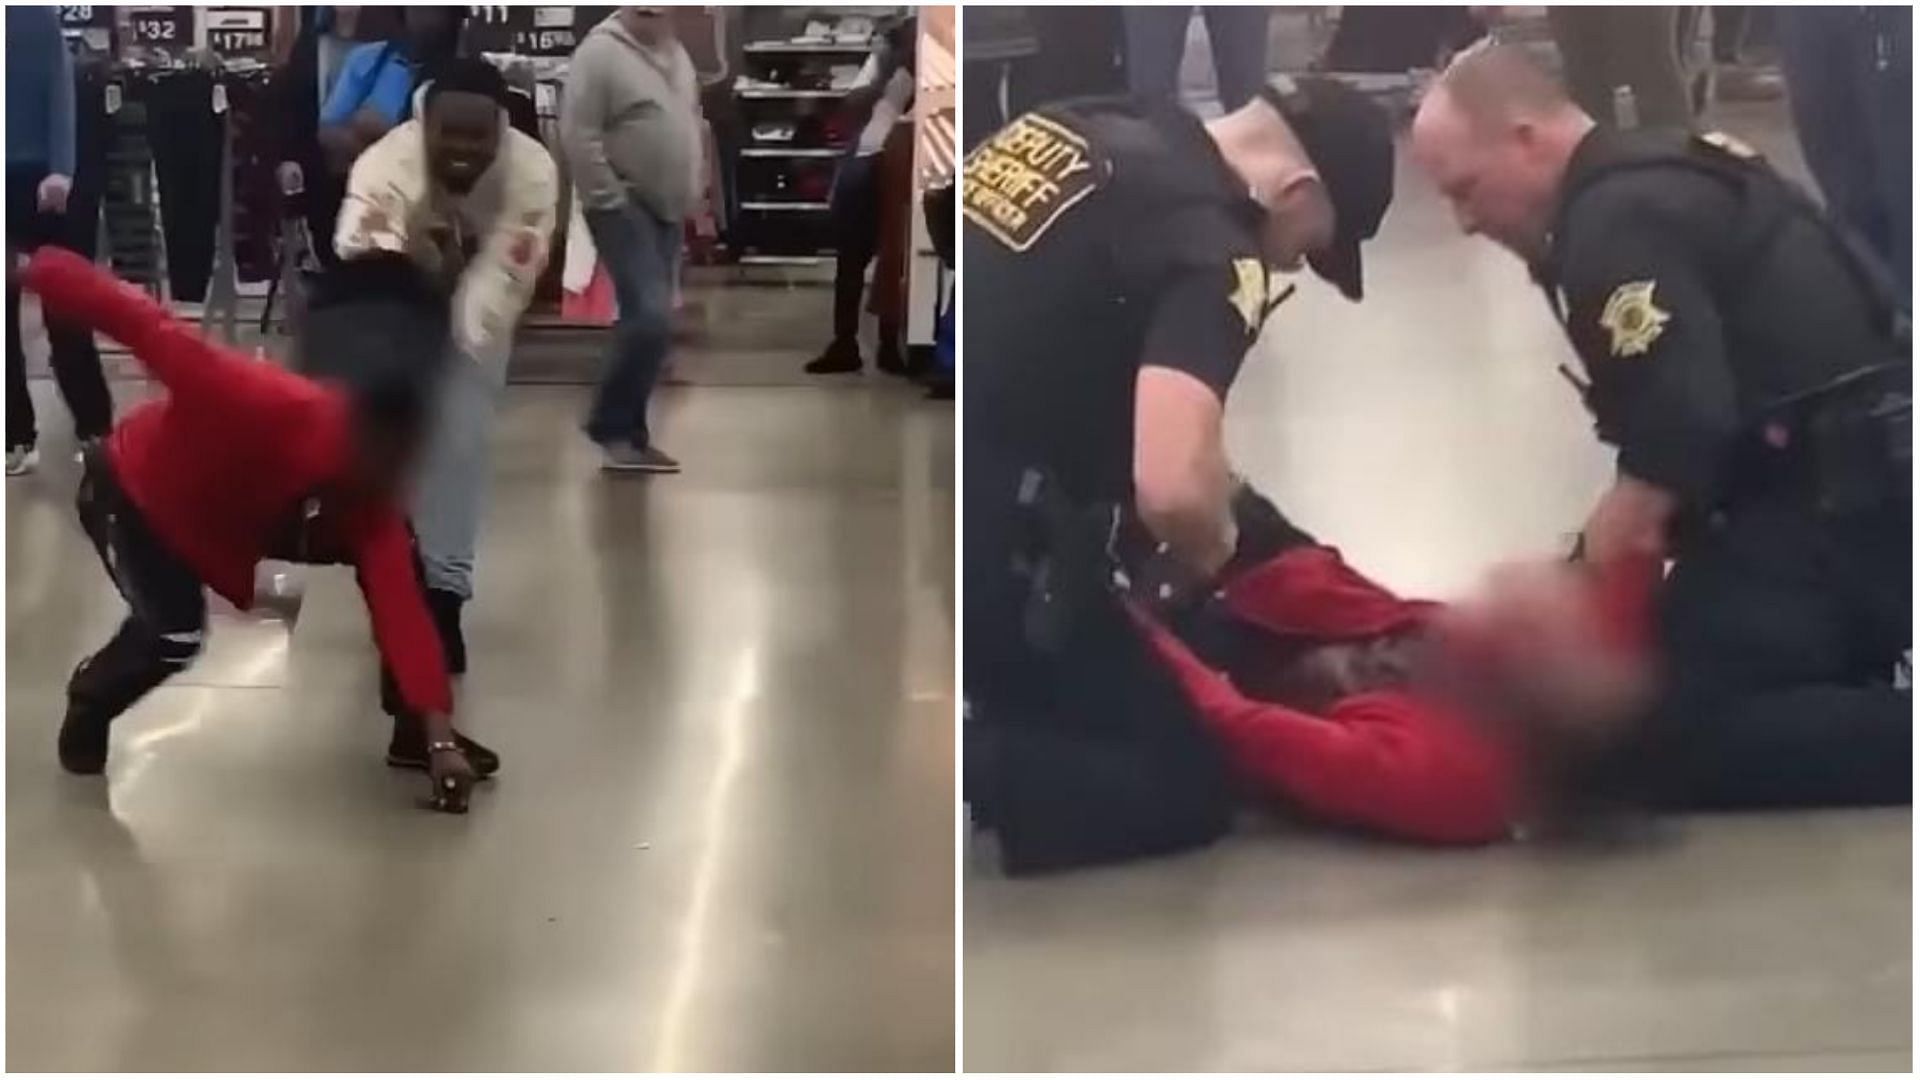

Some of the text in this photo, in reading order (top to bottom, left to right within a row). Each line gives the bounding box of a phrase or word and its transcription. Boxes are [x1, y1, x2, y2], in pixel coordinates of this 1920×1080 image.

[139, 20, 176, 40] $32
[964, 147, 1061, 208] SHERIFF
[995, 120, 1091, 182] DEPUTY
